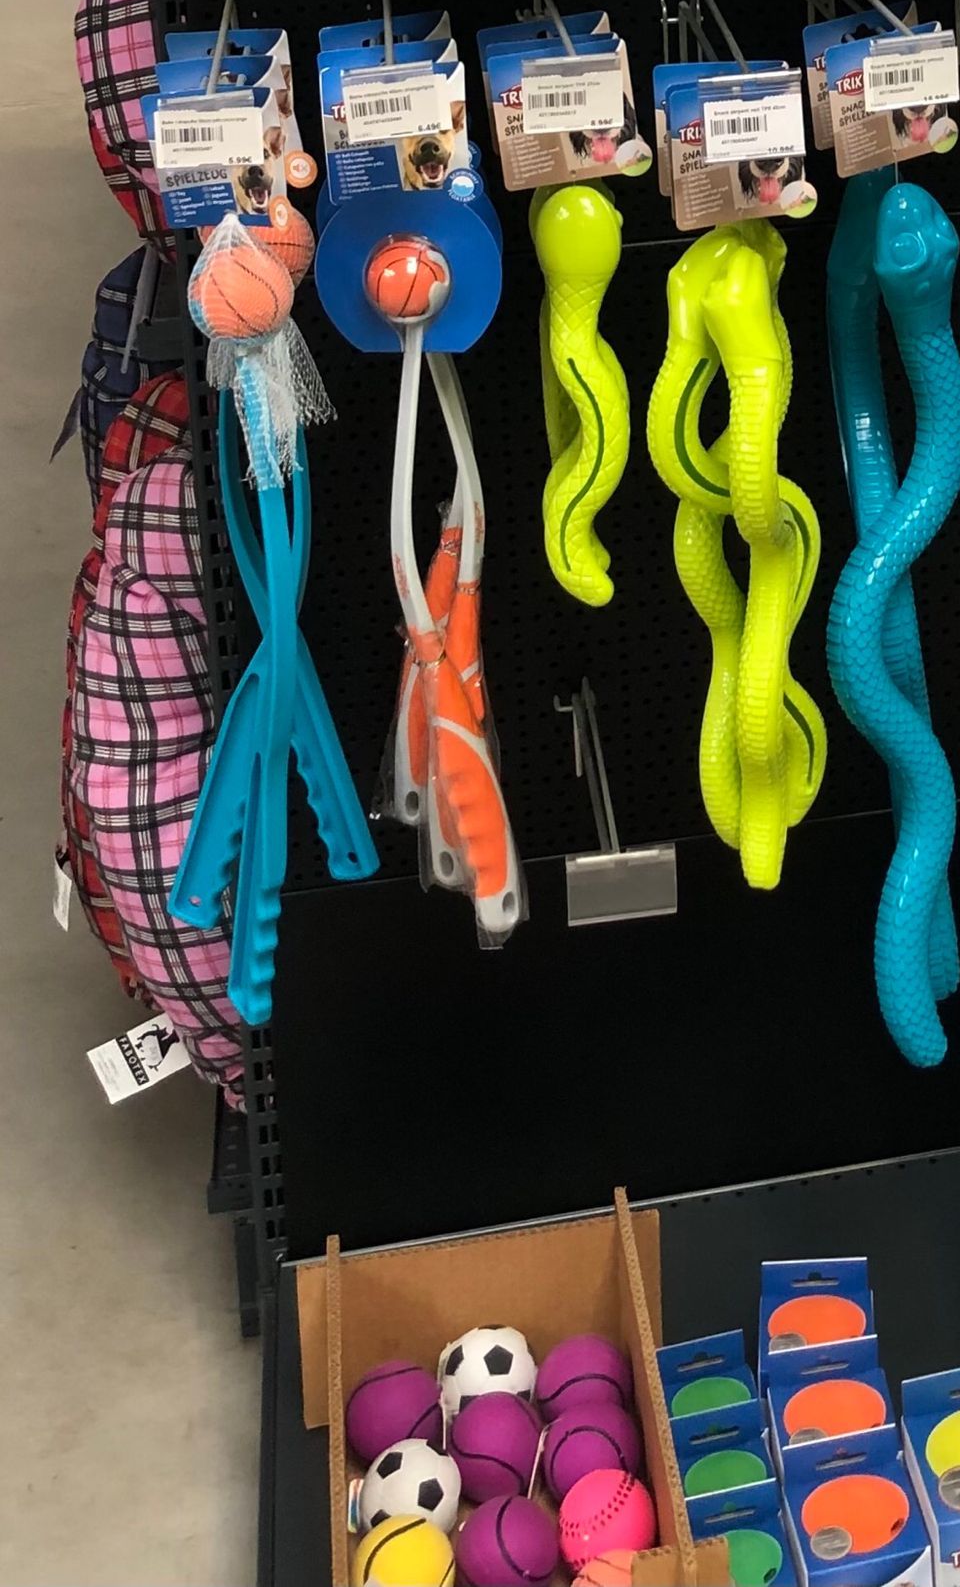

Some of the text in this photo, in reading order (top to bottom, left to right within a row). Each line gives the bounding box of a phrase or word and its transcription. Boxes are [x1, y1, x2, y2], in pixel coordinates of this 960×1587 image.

[418, 122, 441, 132] 6.49€
[166, 169, 228, 188] SPIELZEUG
[118, 1037, 147, 1085] FABOTEX
